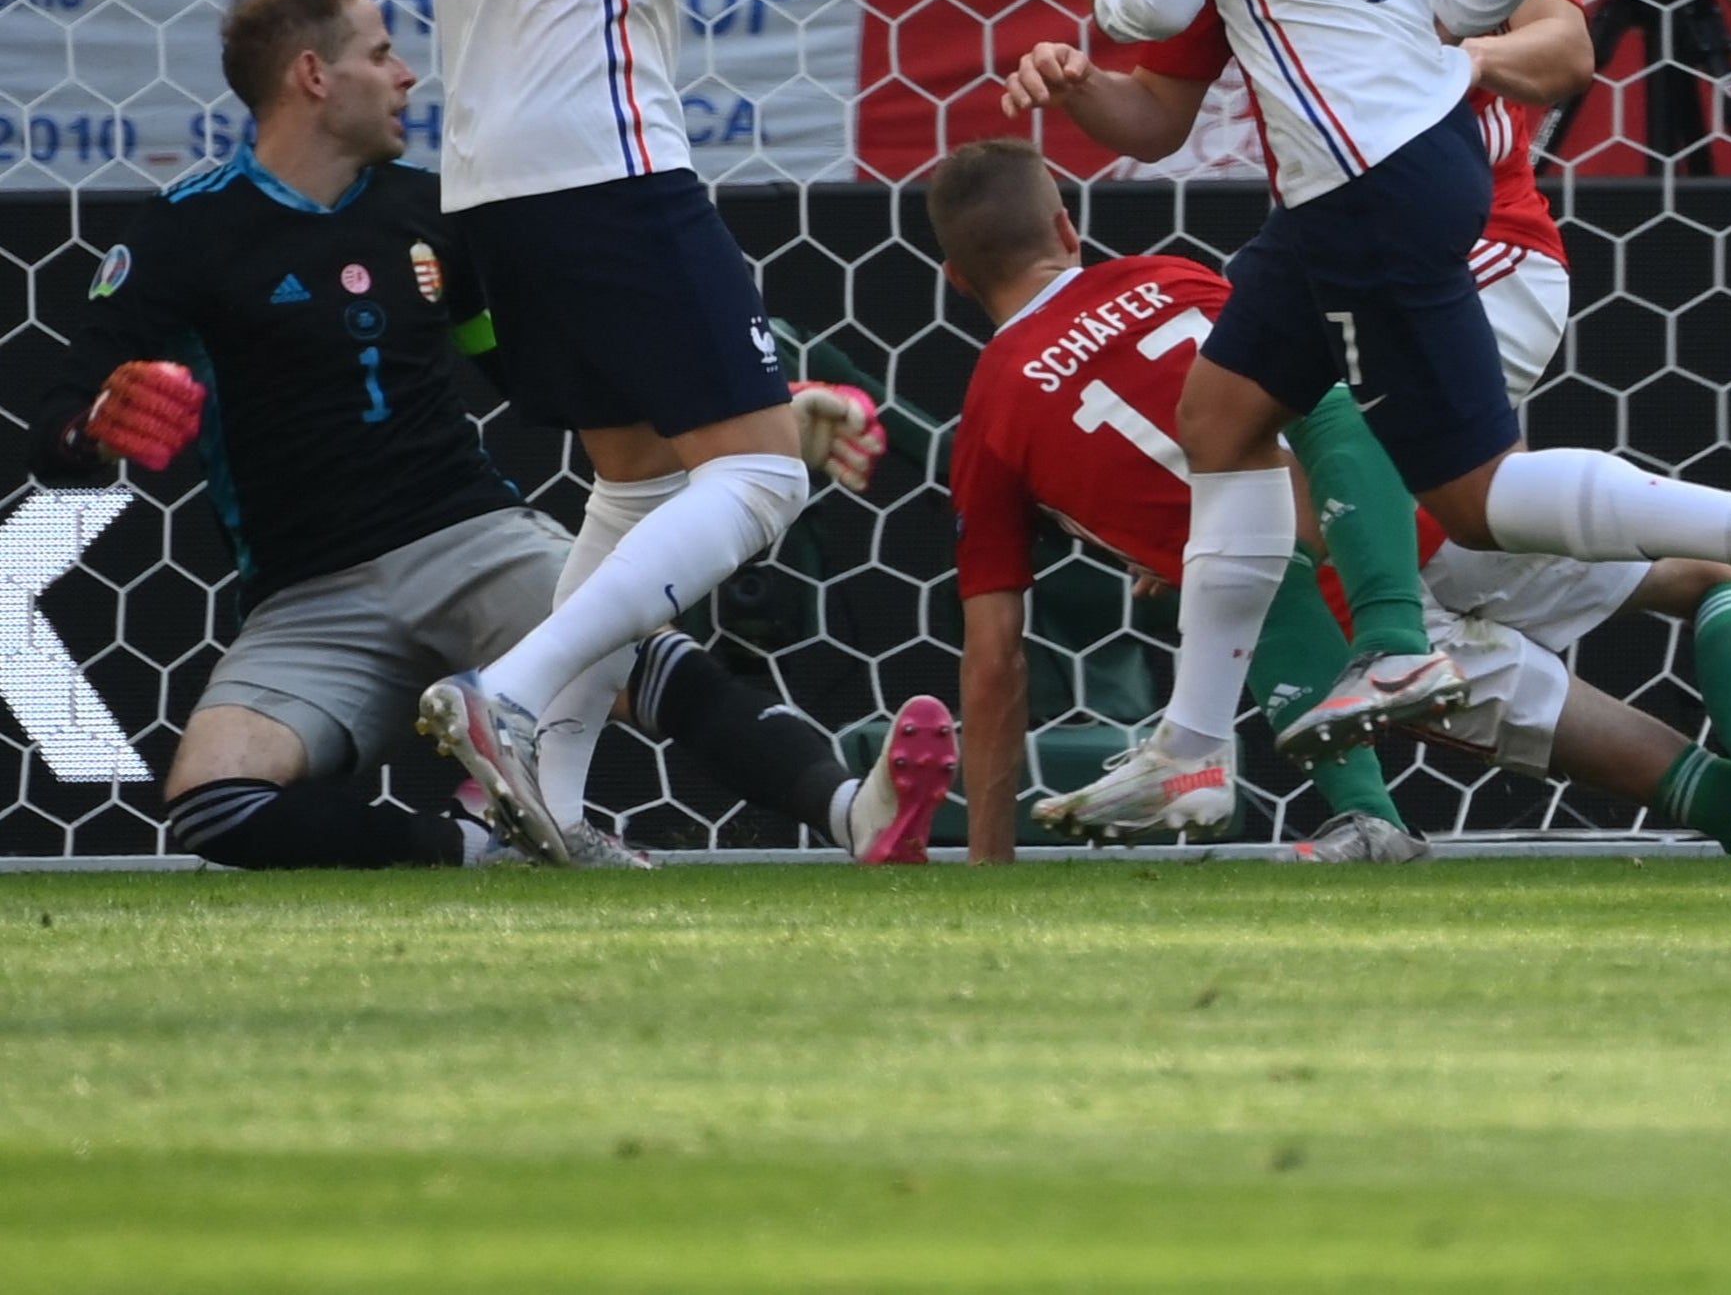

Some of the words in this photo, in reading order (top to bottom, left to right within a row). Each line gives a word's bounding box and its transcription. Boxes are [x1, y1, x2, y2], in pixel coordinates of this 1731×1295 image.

[1022, 281, 1175, 393] SCHÄFER
[1324, 311, 1363, 386] 7
[358, 346, 392, 424] 1
